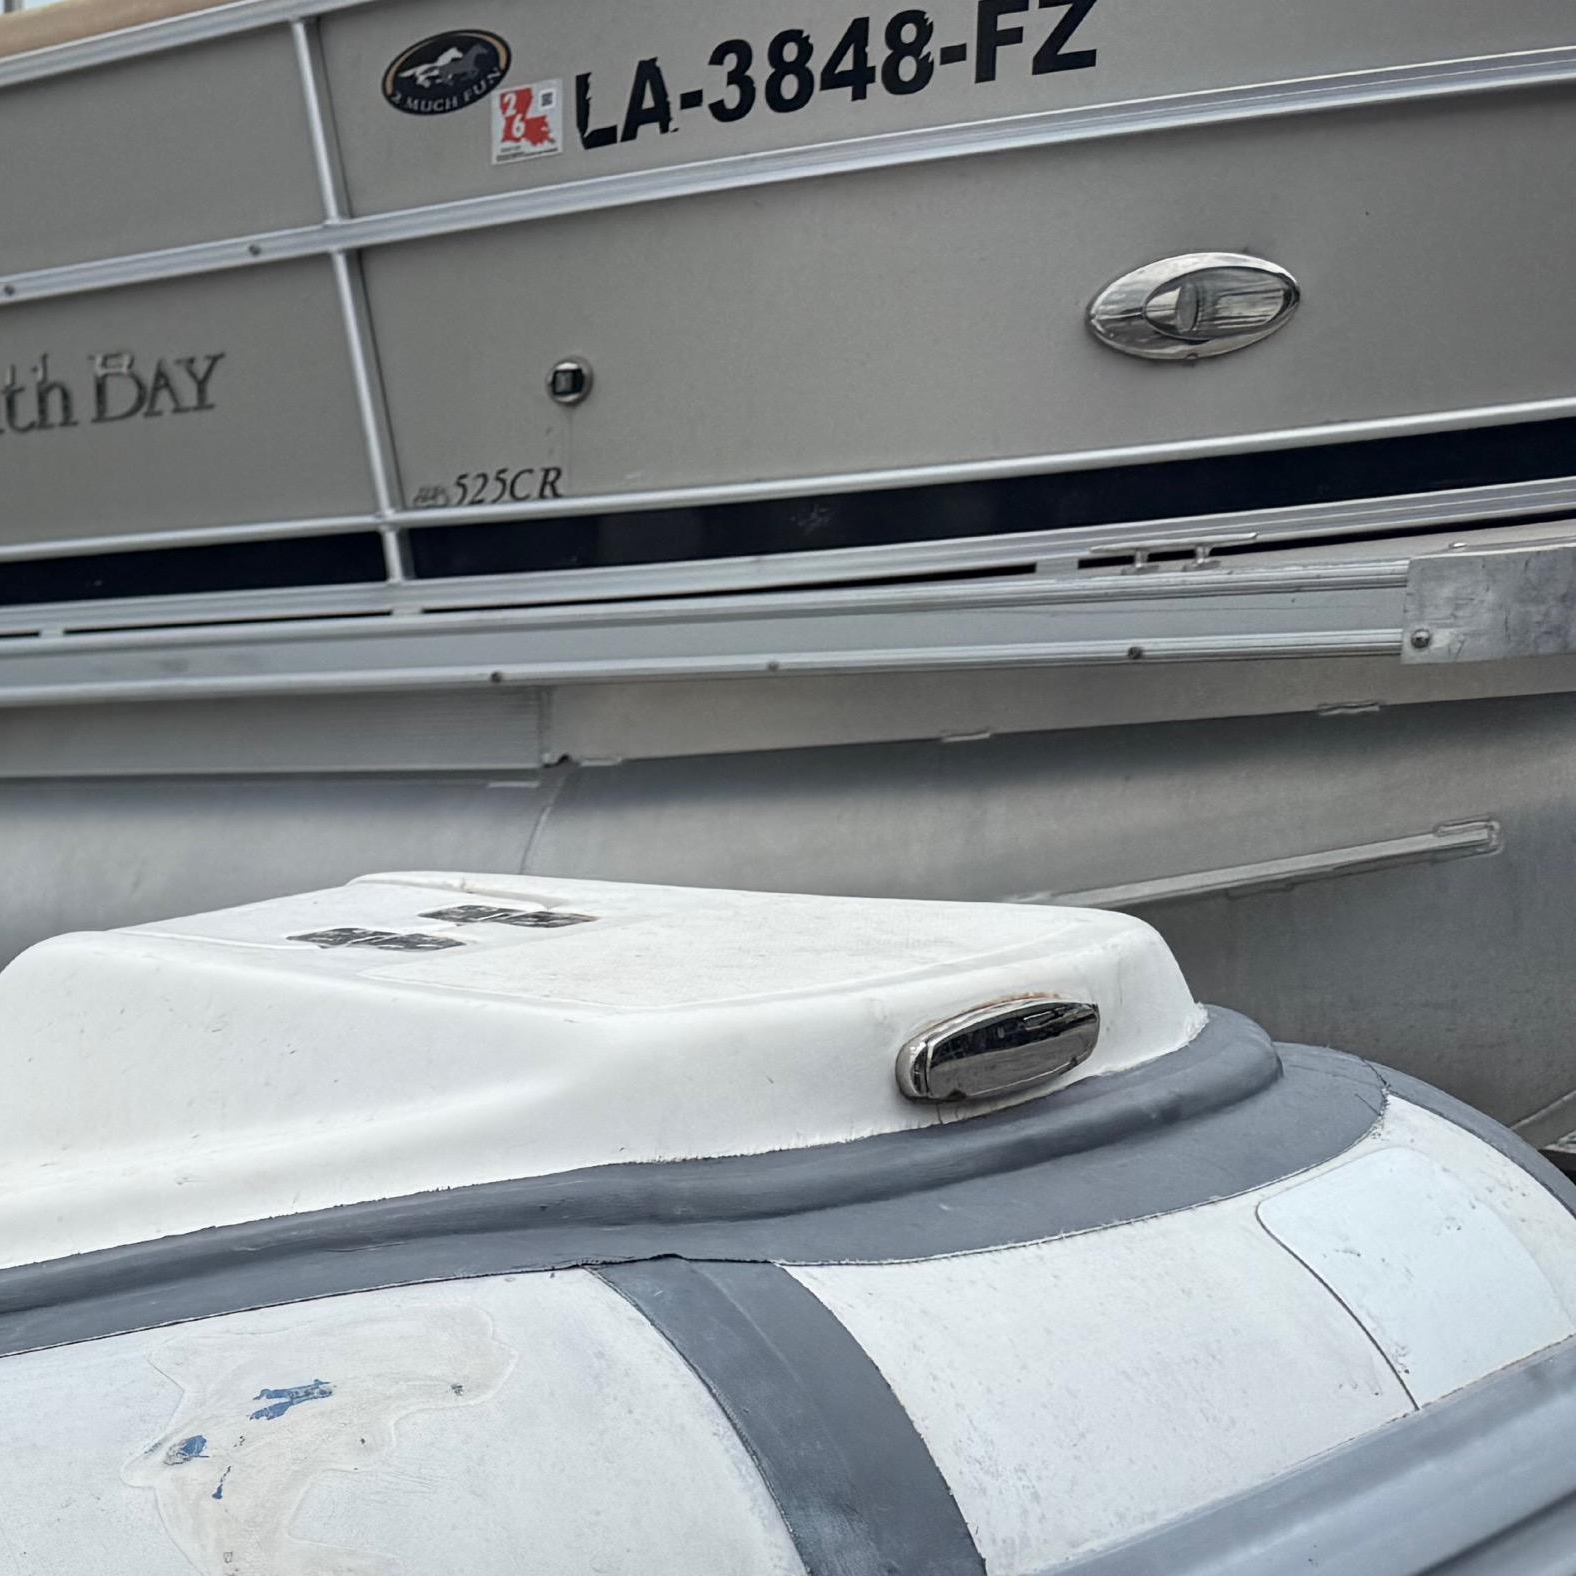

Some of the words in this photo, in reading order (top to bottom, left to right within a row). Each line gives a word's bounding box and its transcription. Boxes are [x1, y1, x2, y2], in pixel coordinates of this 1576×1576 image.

[575, 0, 1097, 149] LA-3848-FZ
[405, 94, 459, 112] MUCH
[455, 466, 563, 506] 525CR
